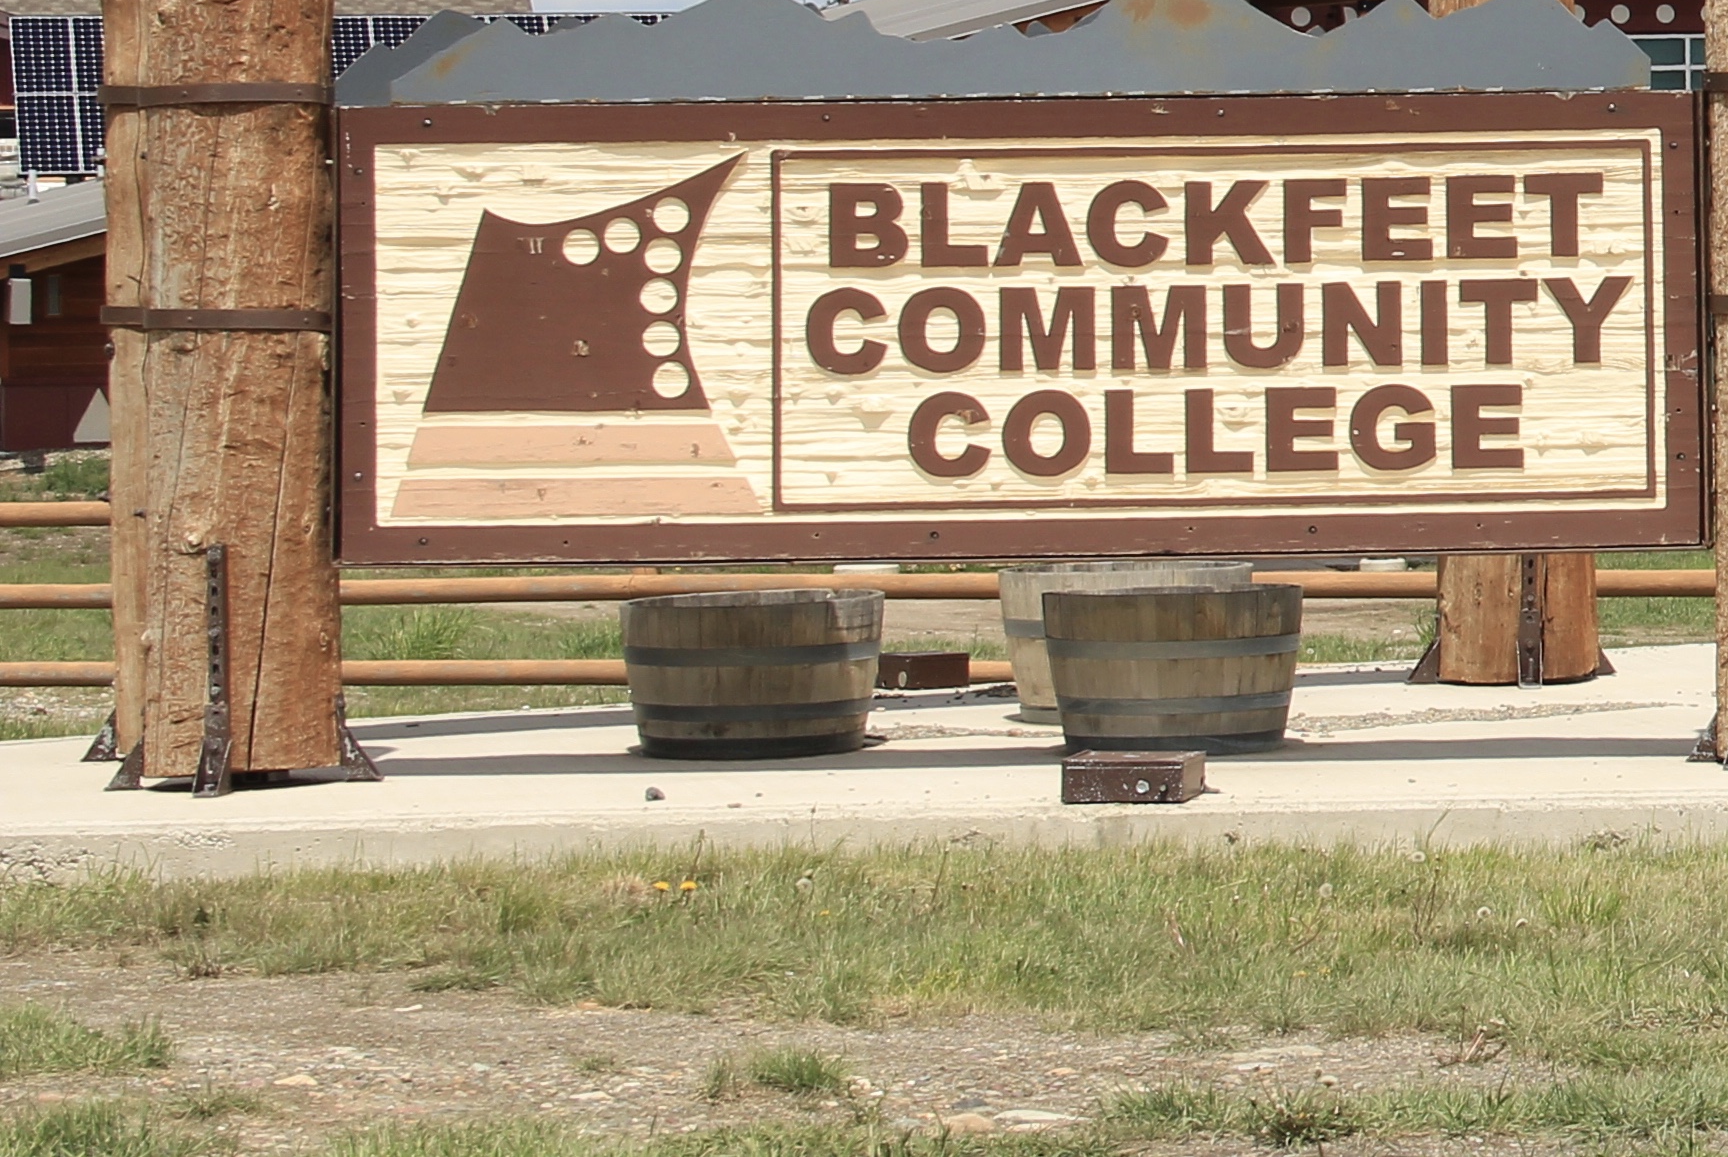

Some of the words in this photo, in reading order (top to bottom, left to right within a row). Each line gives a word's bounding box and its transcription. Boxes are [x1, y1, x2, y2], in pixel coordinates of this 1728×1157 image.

[828, 172, 1604, 268] BLACKFEET
[805, 275, 1635, 375] COMMUNITY
[907, 383, 1525, 477] COLLEGE
